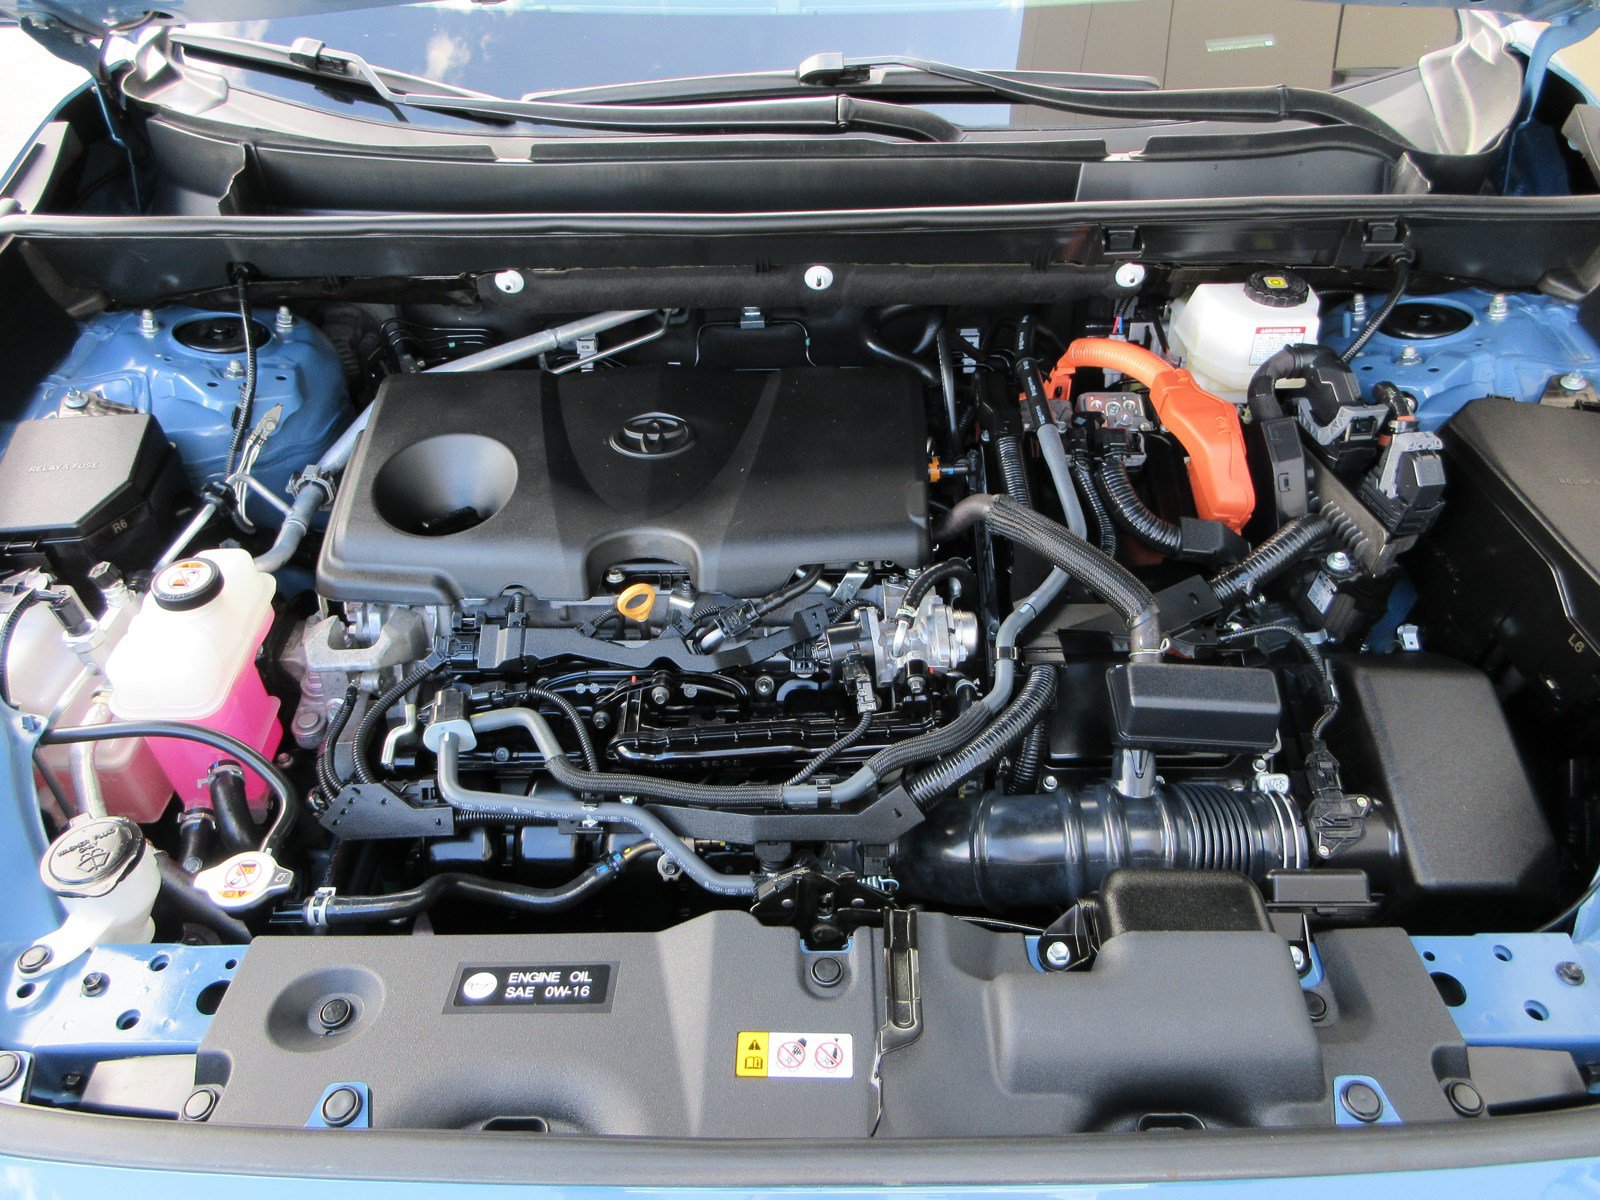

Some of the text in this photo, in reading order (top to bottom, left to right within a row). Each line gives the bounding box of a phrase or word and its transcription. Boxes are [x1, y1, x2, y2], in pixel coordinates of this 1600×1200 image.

[28, 464, 61, 473] RELAY
[72, 461, 100, 471] FUSE
[112, 518, 128, 535] R6
[1568, 633, 1585, 653] L6
[508, 971, 593, 984] ENGINE OIL
[504, 985, 591, 998] SAE 0W-16
